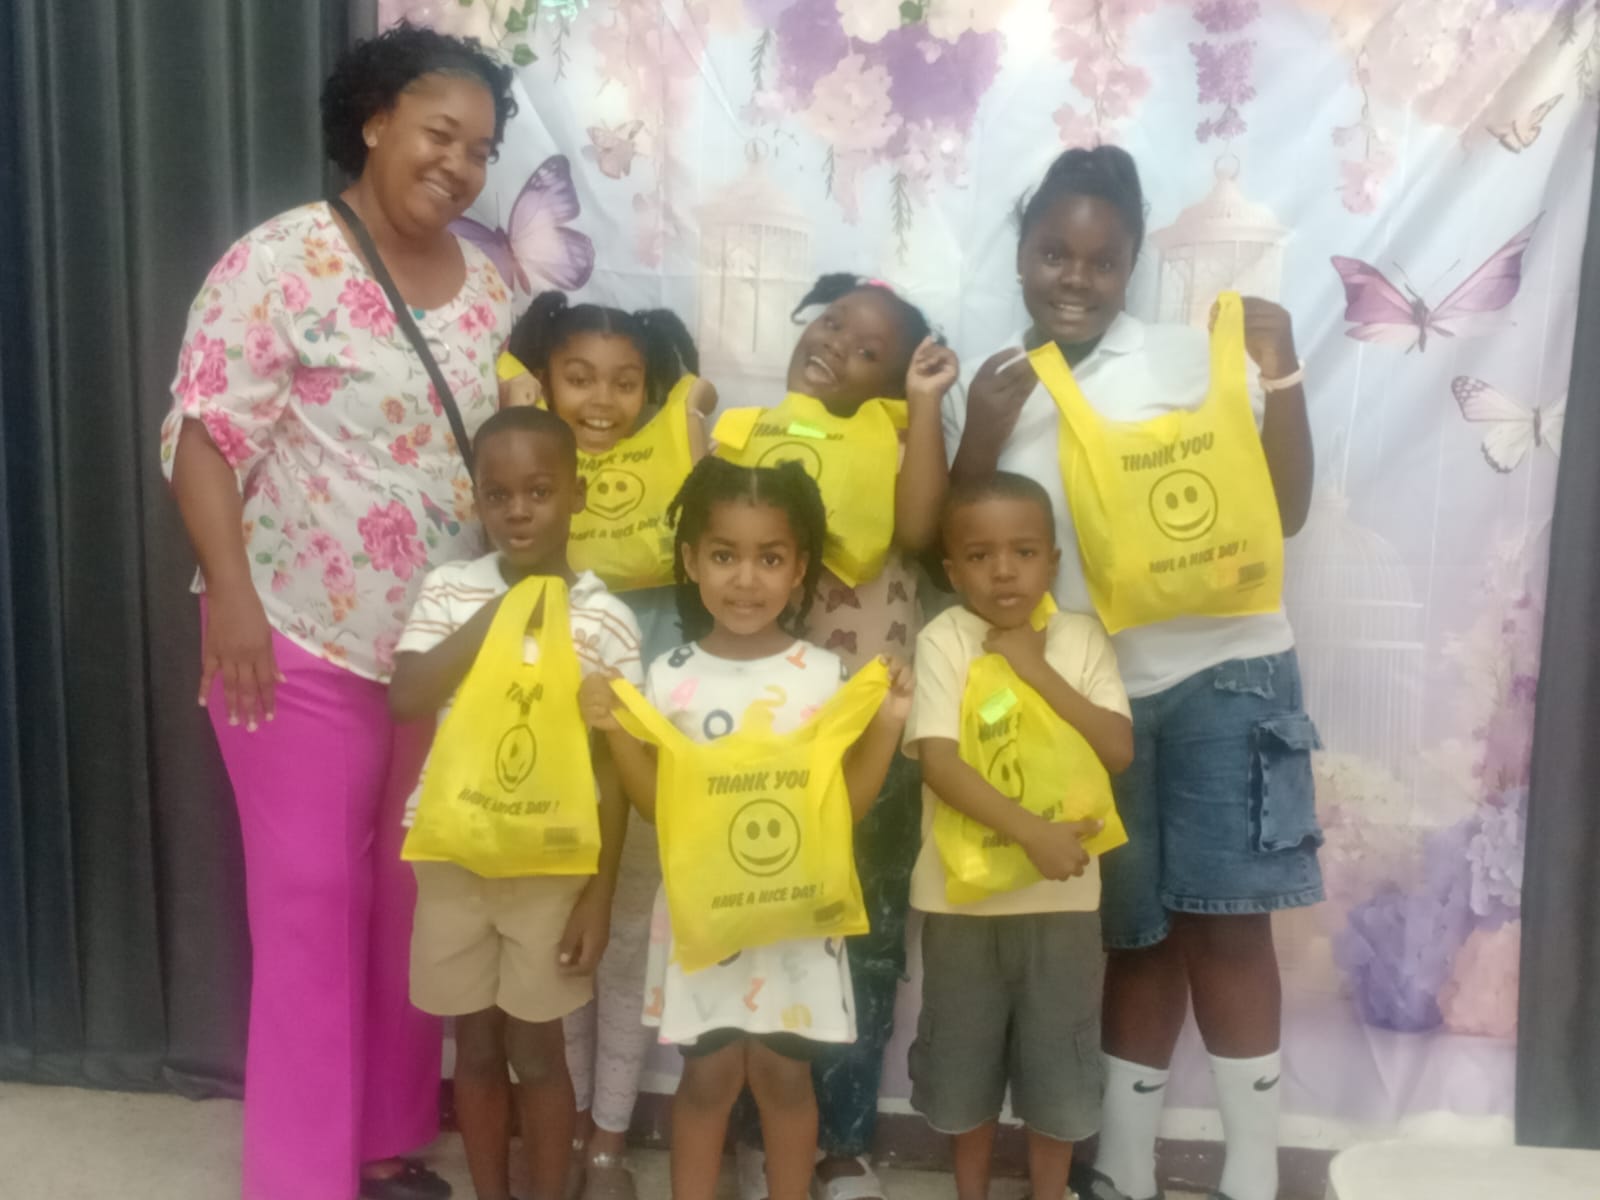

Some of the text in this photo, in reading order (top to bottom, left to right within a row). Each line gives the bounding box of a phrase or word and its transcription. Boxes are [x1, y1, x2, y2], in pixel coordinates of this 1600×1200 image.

[1121, 432, 1214, 472] THANK YOU
[1178, 555, 1187, 569] A
[1189, 546, 1216, 566] NICE
[707, 769, 811, 796] THANK YOU
[525, 801, 552, 815] DAY
[711, 890, 744, 910] HAVE
[746, 890, 755, 905] A
[758, 886, 788, 904] NICE
[791, 883, 818, 900] DAY
